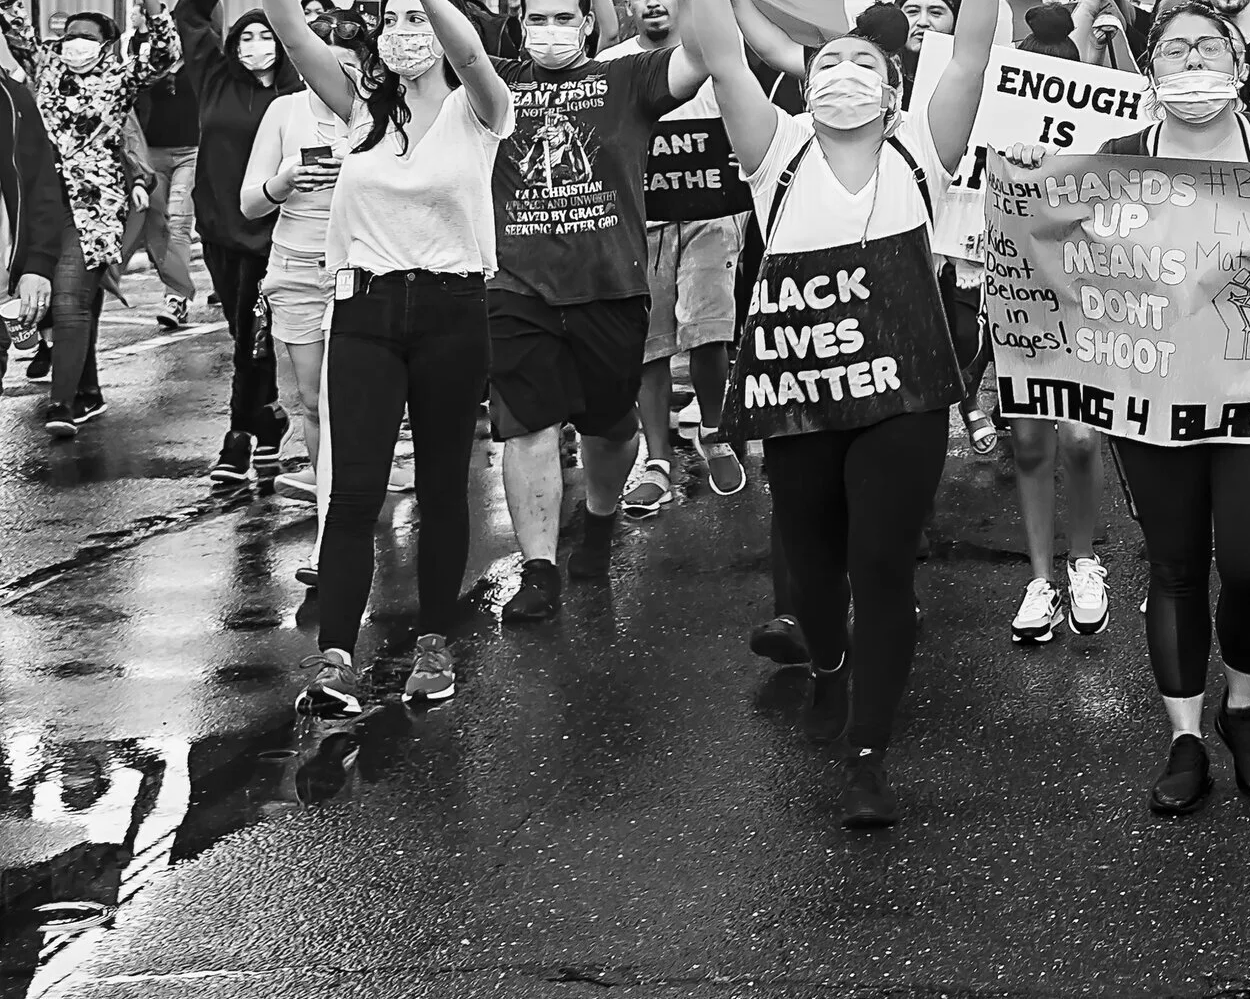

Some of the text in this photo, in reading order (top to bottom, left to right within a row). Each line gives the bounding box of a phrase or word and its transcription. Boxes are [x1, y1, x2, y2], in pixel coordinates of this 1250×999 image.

[511, 90, 551, 107] EAM
[996, 64, 1141, 121] ENOUGH
[652, 132, 709, 157] ANT
[1038, 115, 1077, 149] IS
[541, 180, 603, 200] CHRISTIAN
[644, 168, 722, 191] ATHE
[1043, 169, 1198, 208] HANDS
[569, 204, 606, 221] GRACE
[1093, 202, 1150, 238] UP
[988, 221, 1018, 258] Kids
[987, 251, 1035, 280] Dont
[1062, 241, 1187, 286] MEANS
[986, 275, 1060, 312] Belong
[1080, 285, 1169, 331] DONT
[1004, 303, 1029, 324] in
[754, 317, 865, 361] LIVES
[992, 320, 1072, 359] Cages!
[1074, 327, 1177, 378] SHOOT
[744, 355, 902, 410] MATTER
[998, 376, 1115, 431] LATINOS
[1126, 396, 1151, 436] 4
